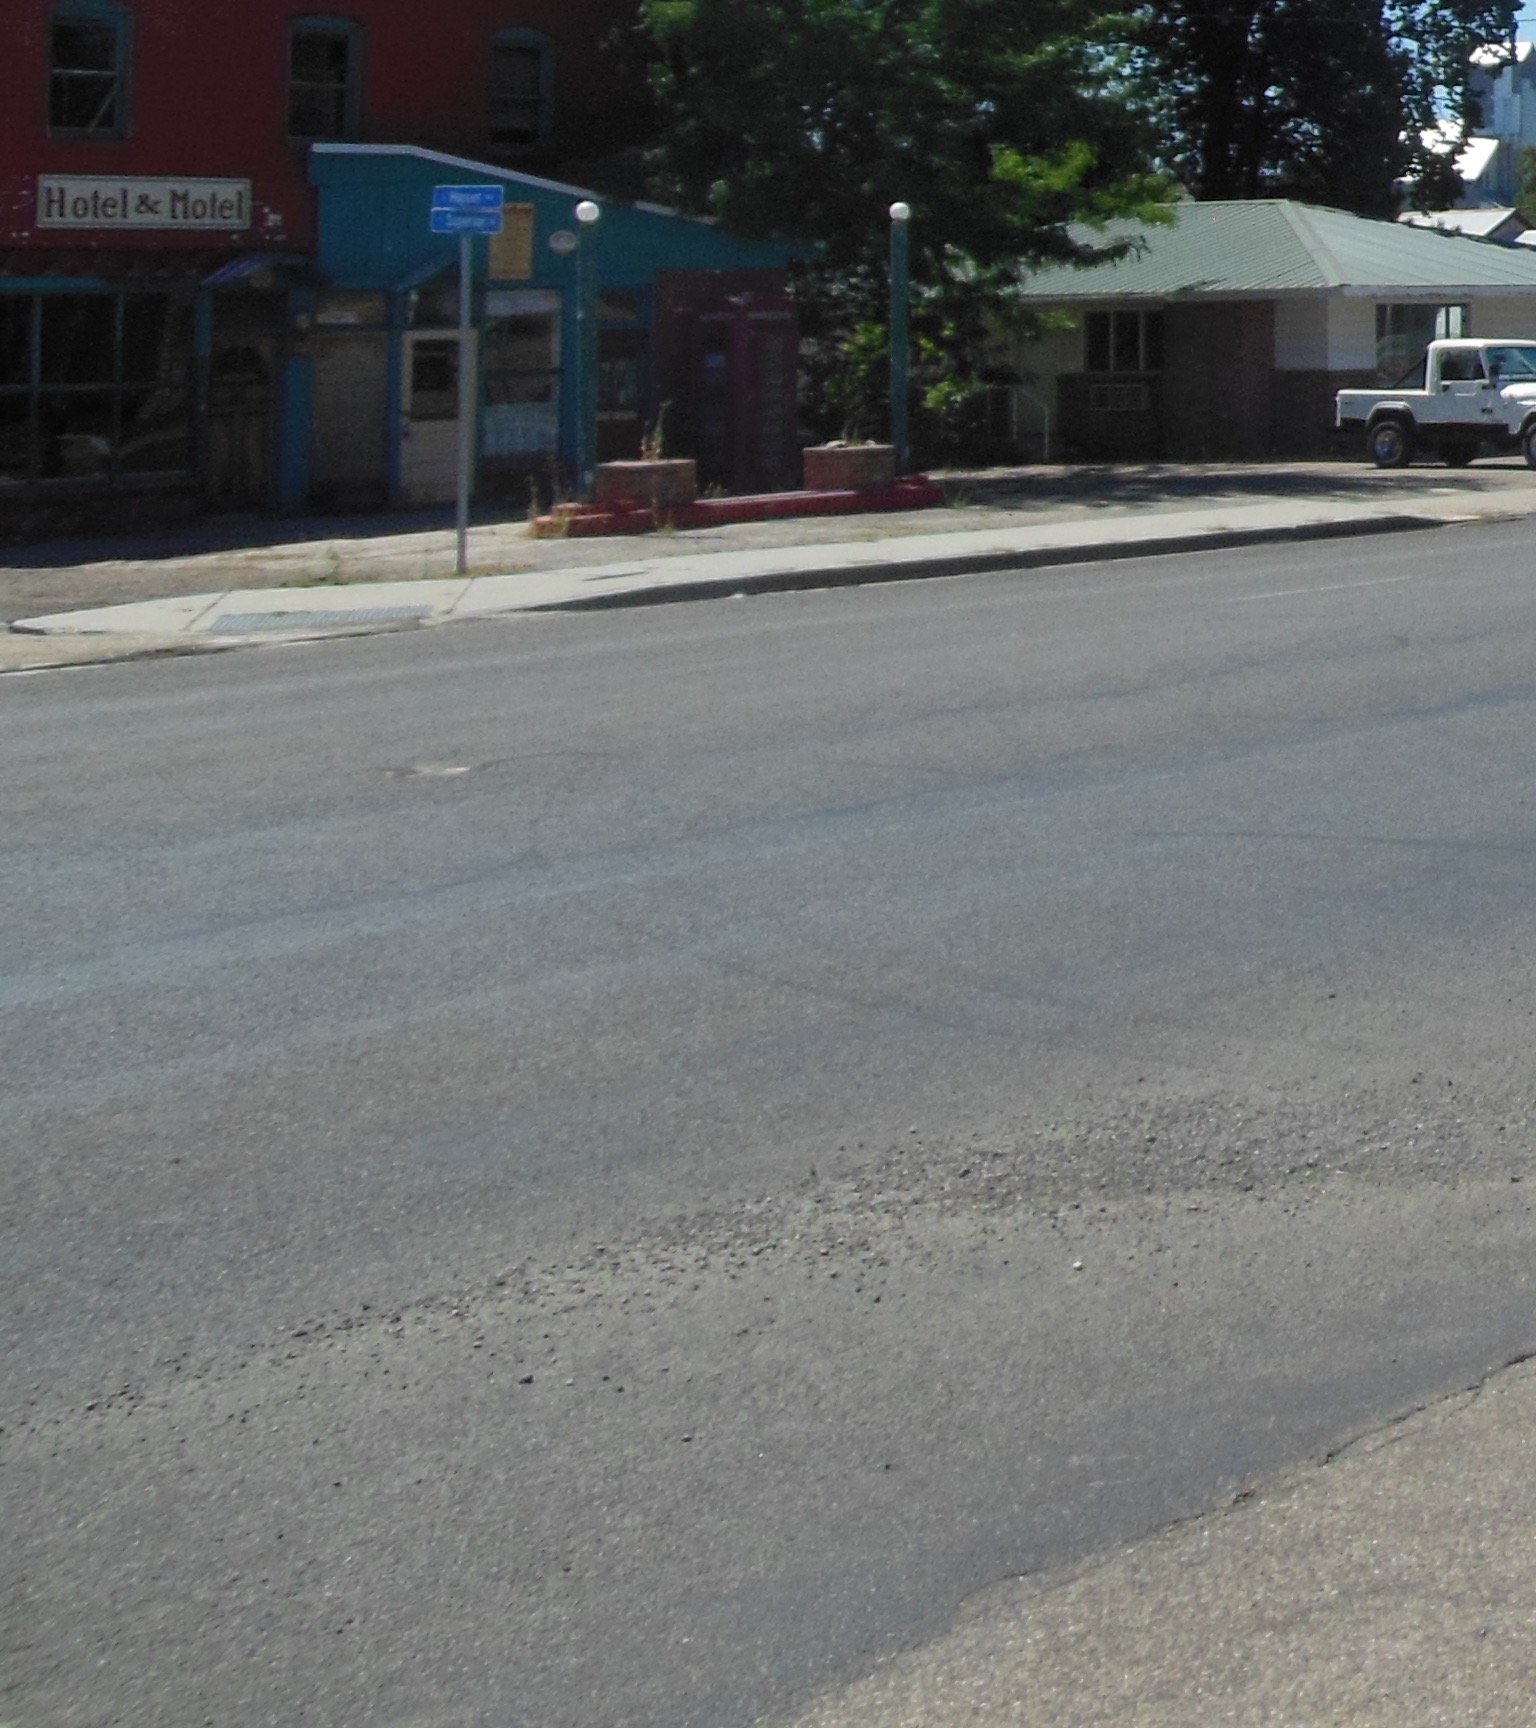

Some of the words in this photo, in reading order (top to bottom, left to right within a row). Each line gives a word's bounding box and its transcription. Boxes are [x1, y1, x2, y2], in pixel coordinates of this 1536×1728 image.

[44, 186, 128, 219] Hotel
[135, 193, 161, 215] &
[170, 189, 244, 220] Motel
